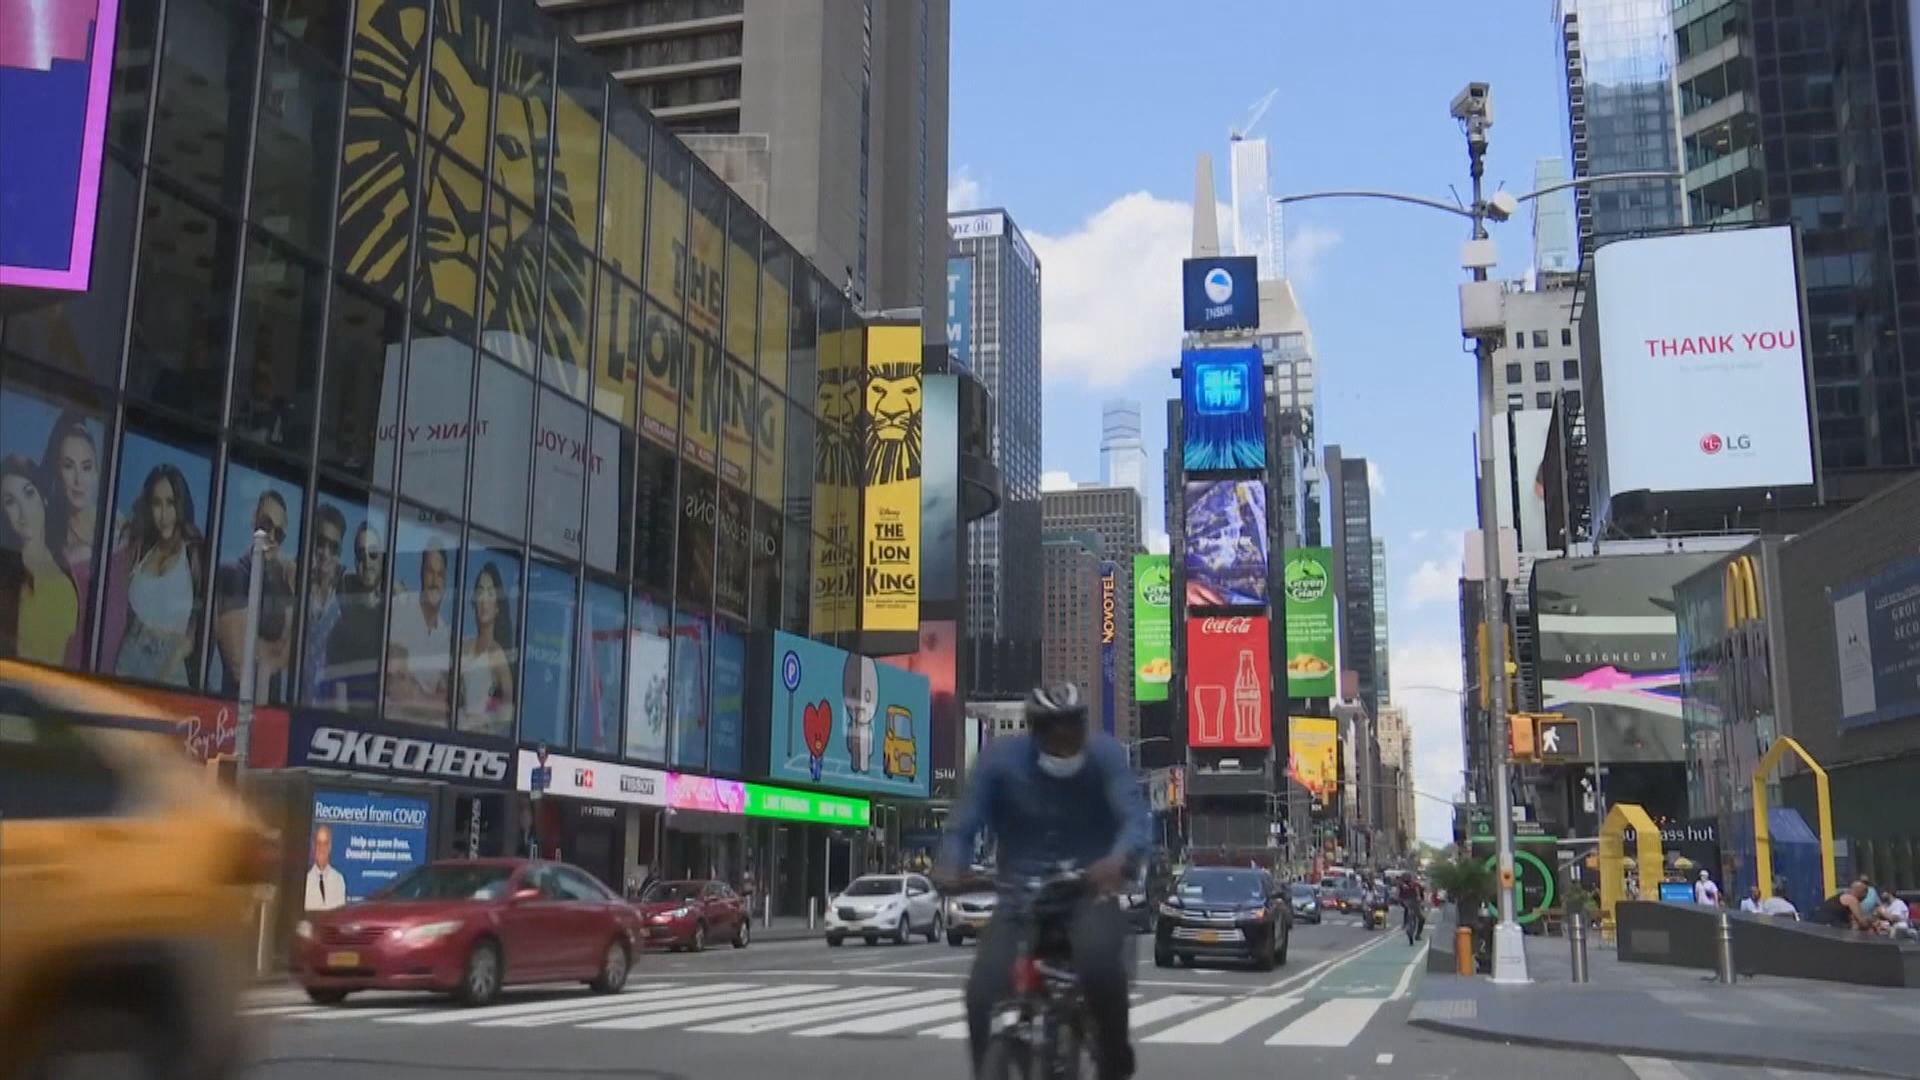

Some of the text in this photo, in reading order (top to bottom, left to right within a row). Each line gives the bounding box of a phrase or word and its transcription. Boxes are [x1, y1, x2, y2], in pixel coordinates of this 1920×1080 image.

[672, 236, 722, 319] THE
[1645, 329, 1796, 358] THANK YOU
[1726, 434, 1751, 450] LG
[875, 523, 904, 537] THE
[869, 540, 910, 565] LION
[866, 566, 916, 597] KING
[1291, 579, 1324, 589] Green
[1102, 571, 1114, 643] NOVOTEL
[1565, 651, 1667, 663] DESIGNED BY
[306, 727, 510, 781] SKECHERS
[622, 776, 653, 794] TISSOT
[315, 802, 426, 826] Recovered from COVID?
[1688, 825, 1714, 841] hut
